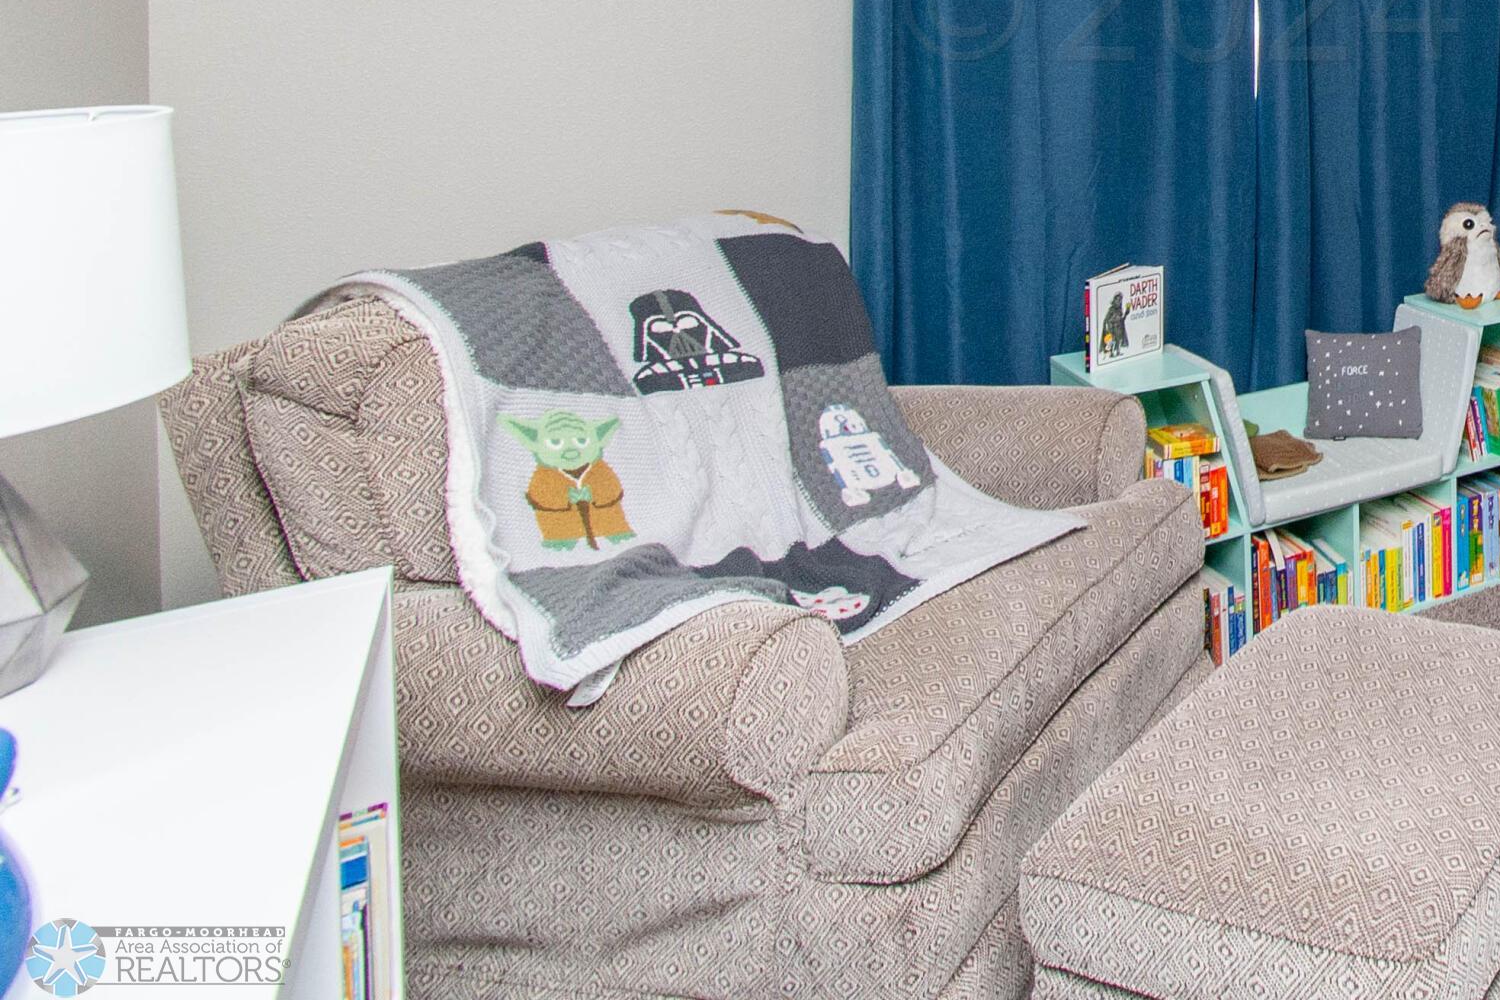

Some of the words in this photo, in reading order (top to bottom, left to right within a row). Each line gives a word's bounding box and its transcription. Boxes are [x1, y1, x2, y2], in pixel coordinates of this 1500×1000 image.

[1130, 278, 1158, 296] DARTH
[1131, 293, 1158, 311] VADER
[1341, 364, 1368, 377] FORCE
